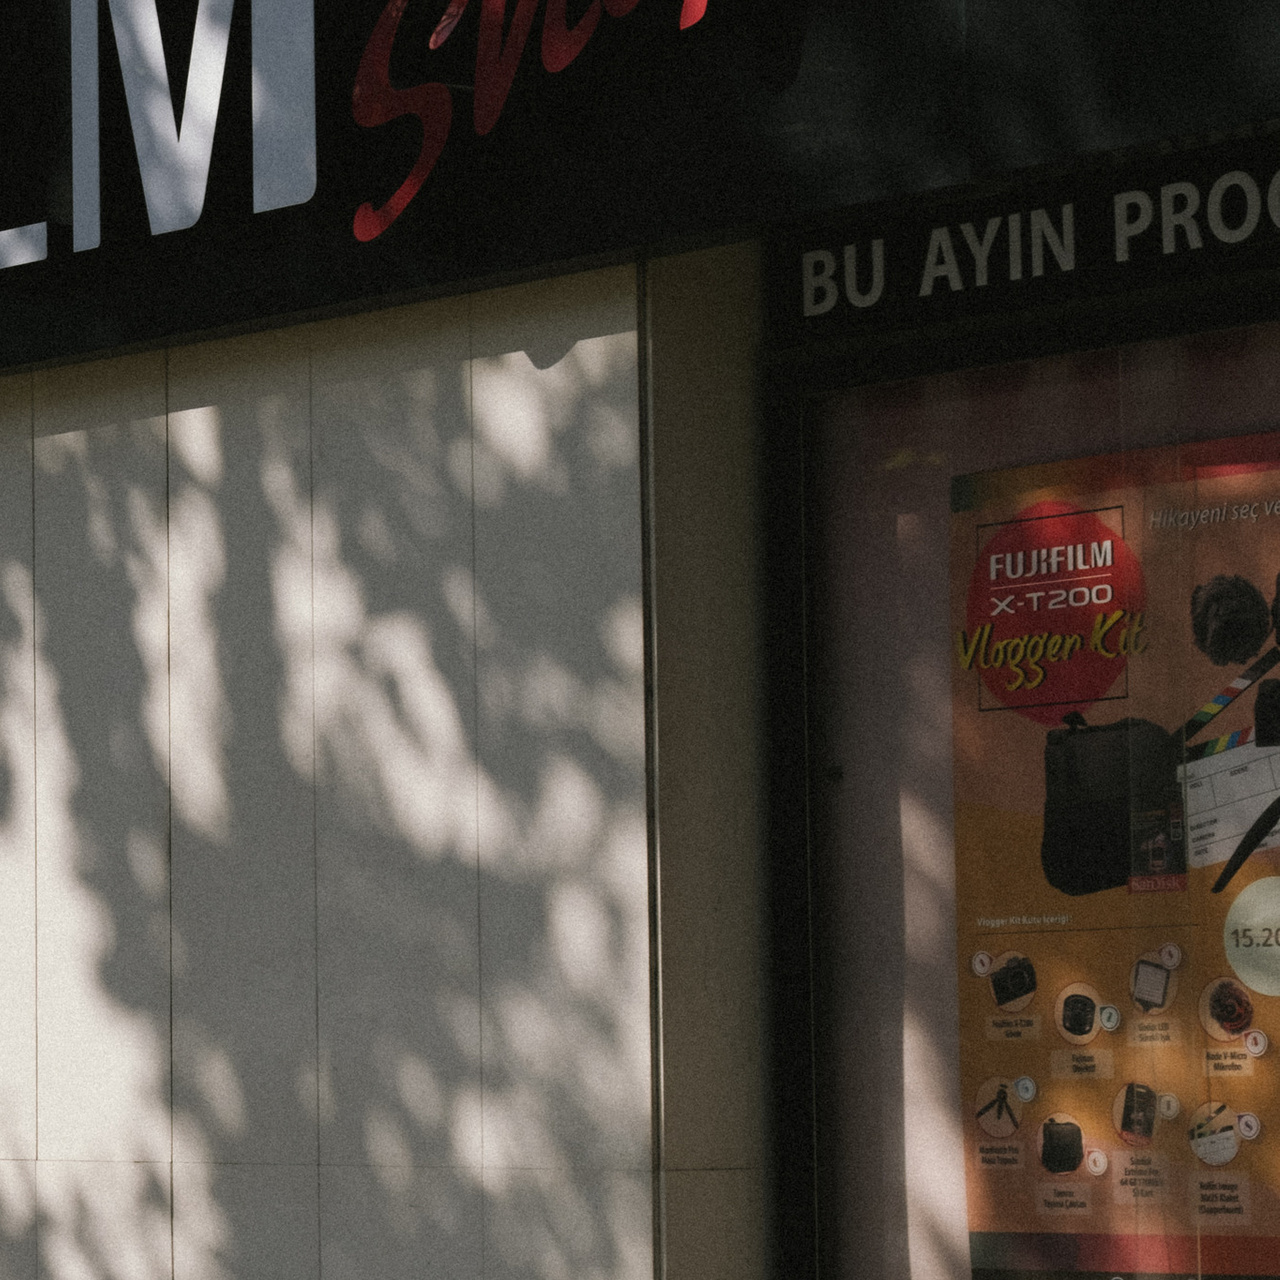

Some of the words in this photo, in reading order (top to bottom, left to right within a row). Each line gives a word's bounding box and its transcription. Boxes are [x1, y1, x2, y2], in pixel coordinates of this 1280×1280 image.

[802, 238, 885, 317] BU
[919, 203, 1076, 297] AYIN
[1114, 170, 1280, 262] PRO
[1148, 502, 1227, 531] Hikayeni
[1231, 502, 1258, 522] seç
[989, 539, 1113, 580] FUJIFILM
[990, 584, 1113, 617] X-T200
[956, 623, 1084, 691] Vlogger
[1090, 609, 1150, 659] Kit
